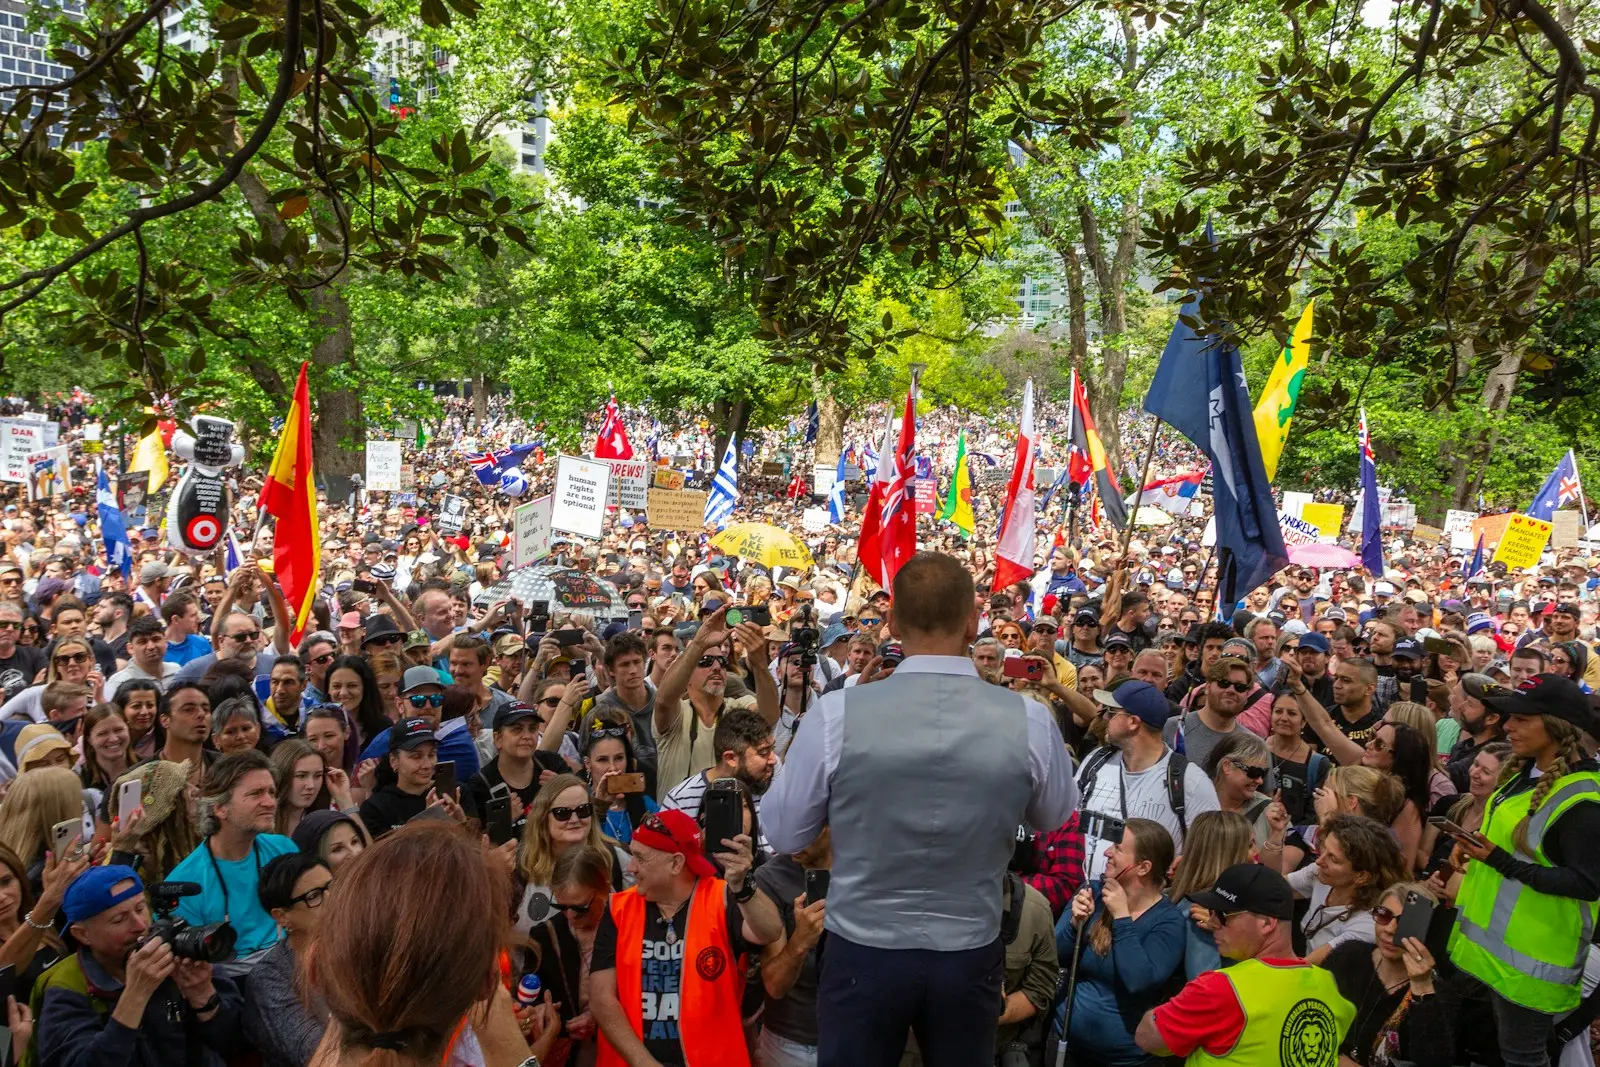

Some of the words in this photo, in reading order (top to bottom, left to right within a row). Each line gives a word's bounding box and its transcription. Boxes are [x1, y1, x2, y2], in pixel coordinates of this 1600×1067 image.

[610, 462, 645, 478] DREWS!
[568, 474, 597, 486] human
[569, 484, 594, 494] rights
[563, 499, 596, 511] optional
[581, 495, 595, 503] not
[1279, 514, 1320, 538] ANDREWS
[749, 532, 765, 543] WE
[1509, 526, 1545, 541] MANDATES
[740, 538, 765, 552] ARE
[1517, 536, 1531, 544] ARE
[1504, 546, 1533, 560] FAMILIES
[1506, 541, 1536, 553] KEEPING
[738, 547, 764, 561] ONE
[779, 548, 799, 559] FREE
[1504, 554, 1527, 564] APART
[562, 592, 587, 605] OUR
[642, 991, 681, 1021] BA
